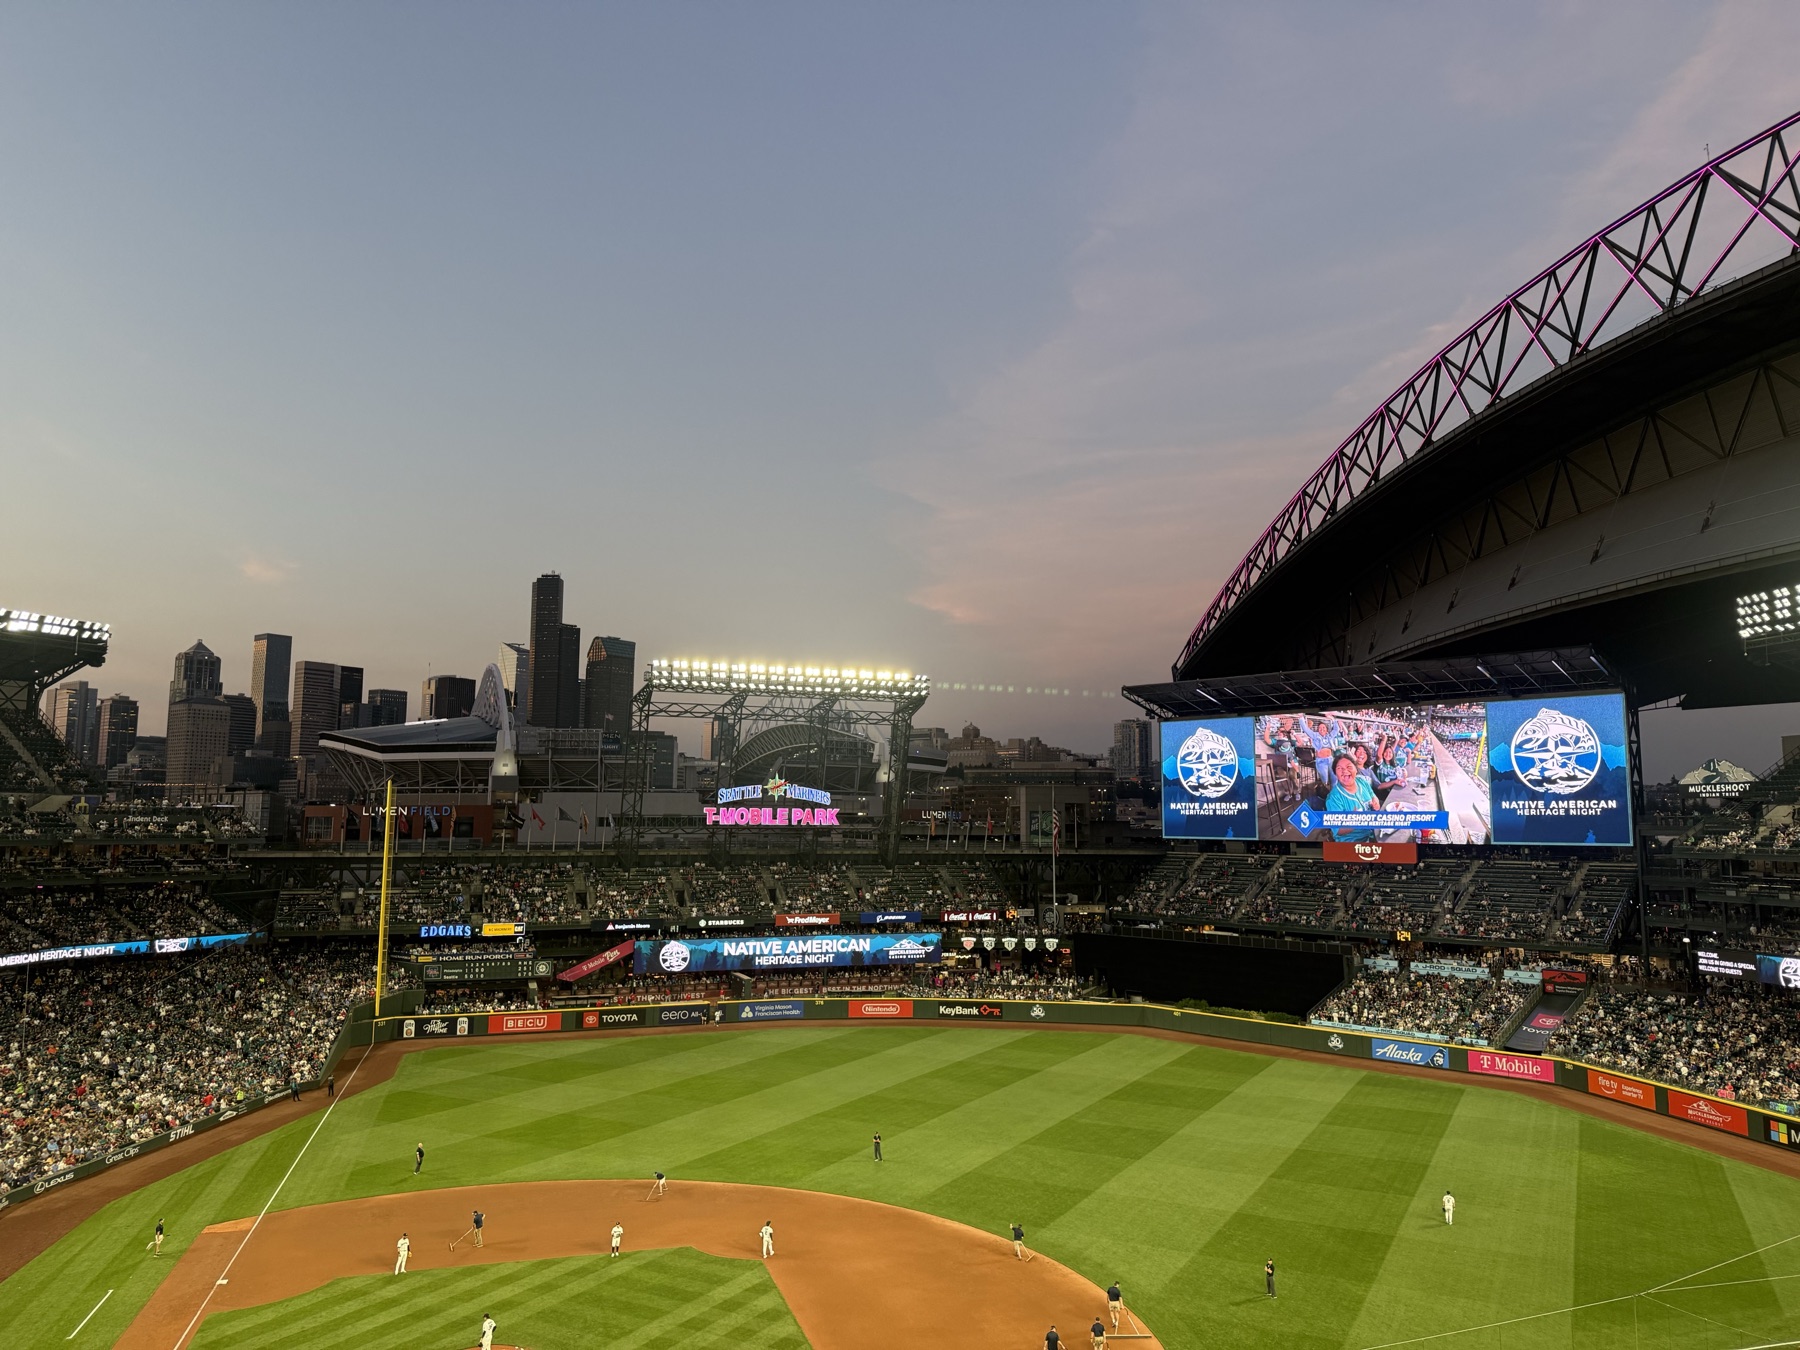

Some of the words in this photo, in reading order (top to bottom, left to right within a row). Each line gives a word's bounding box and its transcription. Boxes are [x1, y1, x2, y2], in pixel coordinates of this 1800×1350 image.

[1689, 784, 1750, 793] MUCKLESHOOT
[718, 785, 762, 804] SEATTLE
[1502, 801, 1545, 809] NATIVE
[1550, 800, 1617, 808] AMERICAN
[411, 807, 451, 816] FIELD
[704, 807, 789, 825] T-MOBILE
[792, 808, 840, 825] PARK
[922, 810, 947, 819] LUMEN
[1517, 808, 1565, 816] HERITAGE
[1323, 814, 1377, 822] MUCKLESHOOT
[1377, 814, 1405, 822] CASINO
[1406, 814, 1437, 822] RESORT
[1354, 844, 1371, 854] fire
[1372, 845, 1382, 854] tv
[420, 925, 471, 937] EDGAR'S
[723, 941, 783, 956] NATIVE
[786, 938, 871, 954] AMERICAN
[0, 953, 39, 967] AMERICAN
[40, 948, 82, 961] HERITAGE
[84, 946, 116, 957] NIGHT
[755, 955, 802, 965] HERITAGE
[805, 954, 834, 964] NIGHT
[588, 957, 605, 970] Mobile
[661, 1010, 688, 1020] eero
[939, 1005, 979, 1016] KeyBank
[507, 1019, 544, 1028] BECU
[602, 1014, 638, 1023] TOYOTA
[1331, 1037, 1340, 1045] 50
[1376, 1043, 1423, 1063] Alaska
[1480, 1055, 1491, 1069] T
[1494, 1056, 1541, 1076] Mobile
[1598, 1076, 1610, 1087] fire
[1610, 1080, 1617, 1089] tv
[1621, 1084, 1643, 1094] Experience
[1687, 1109, 1723, 1123] MUCKLESHOOT
[169, 1124, 195, 1143] STIHL
[105, 1151, 124, 1165] Great
[124, 1147, 140, 1158] Clips
[45, 1172, 75, 1188] LEXUS
